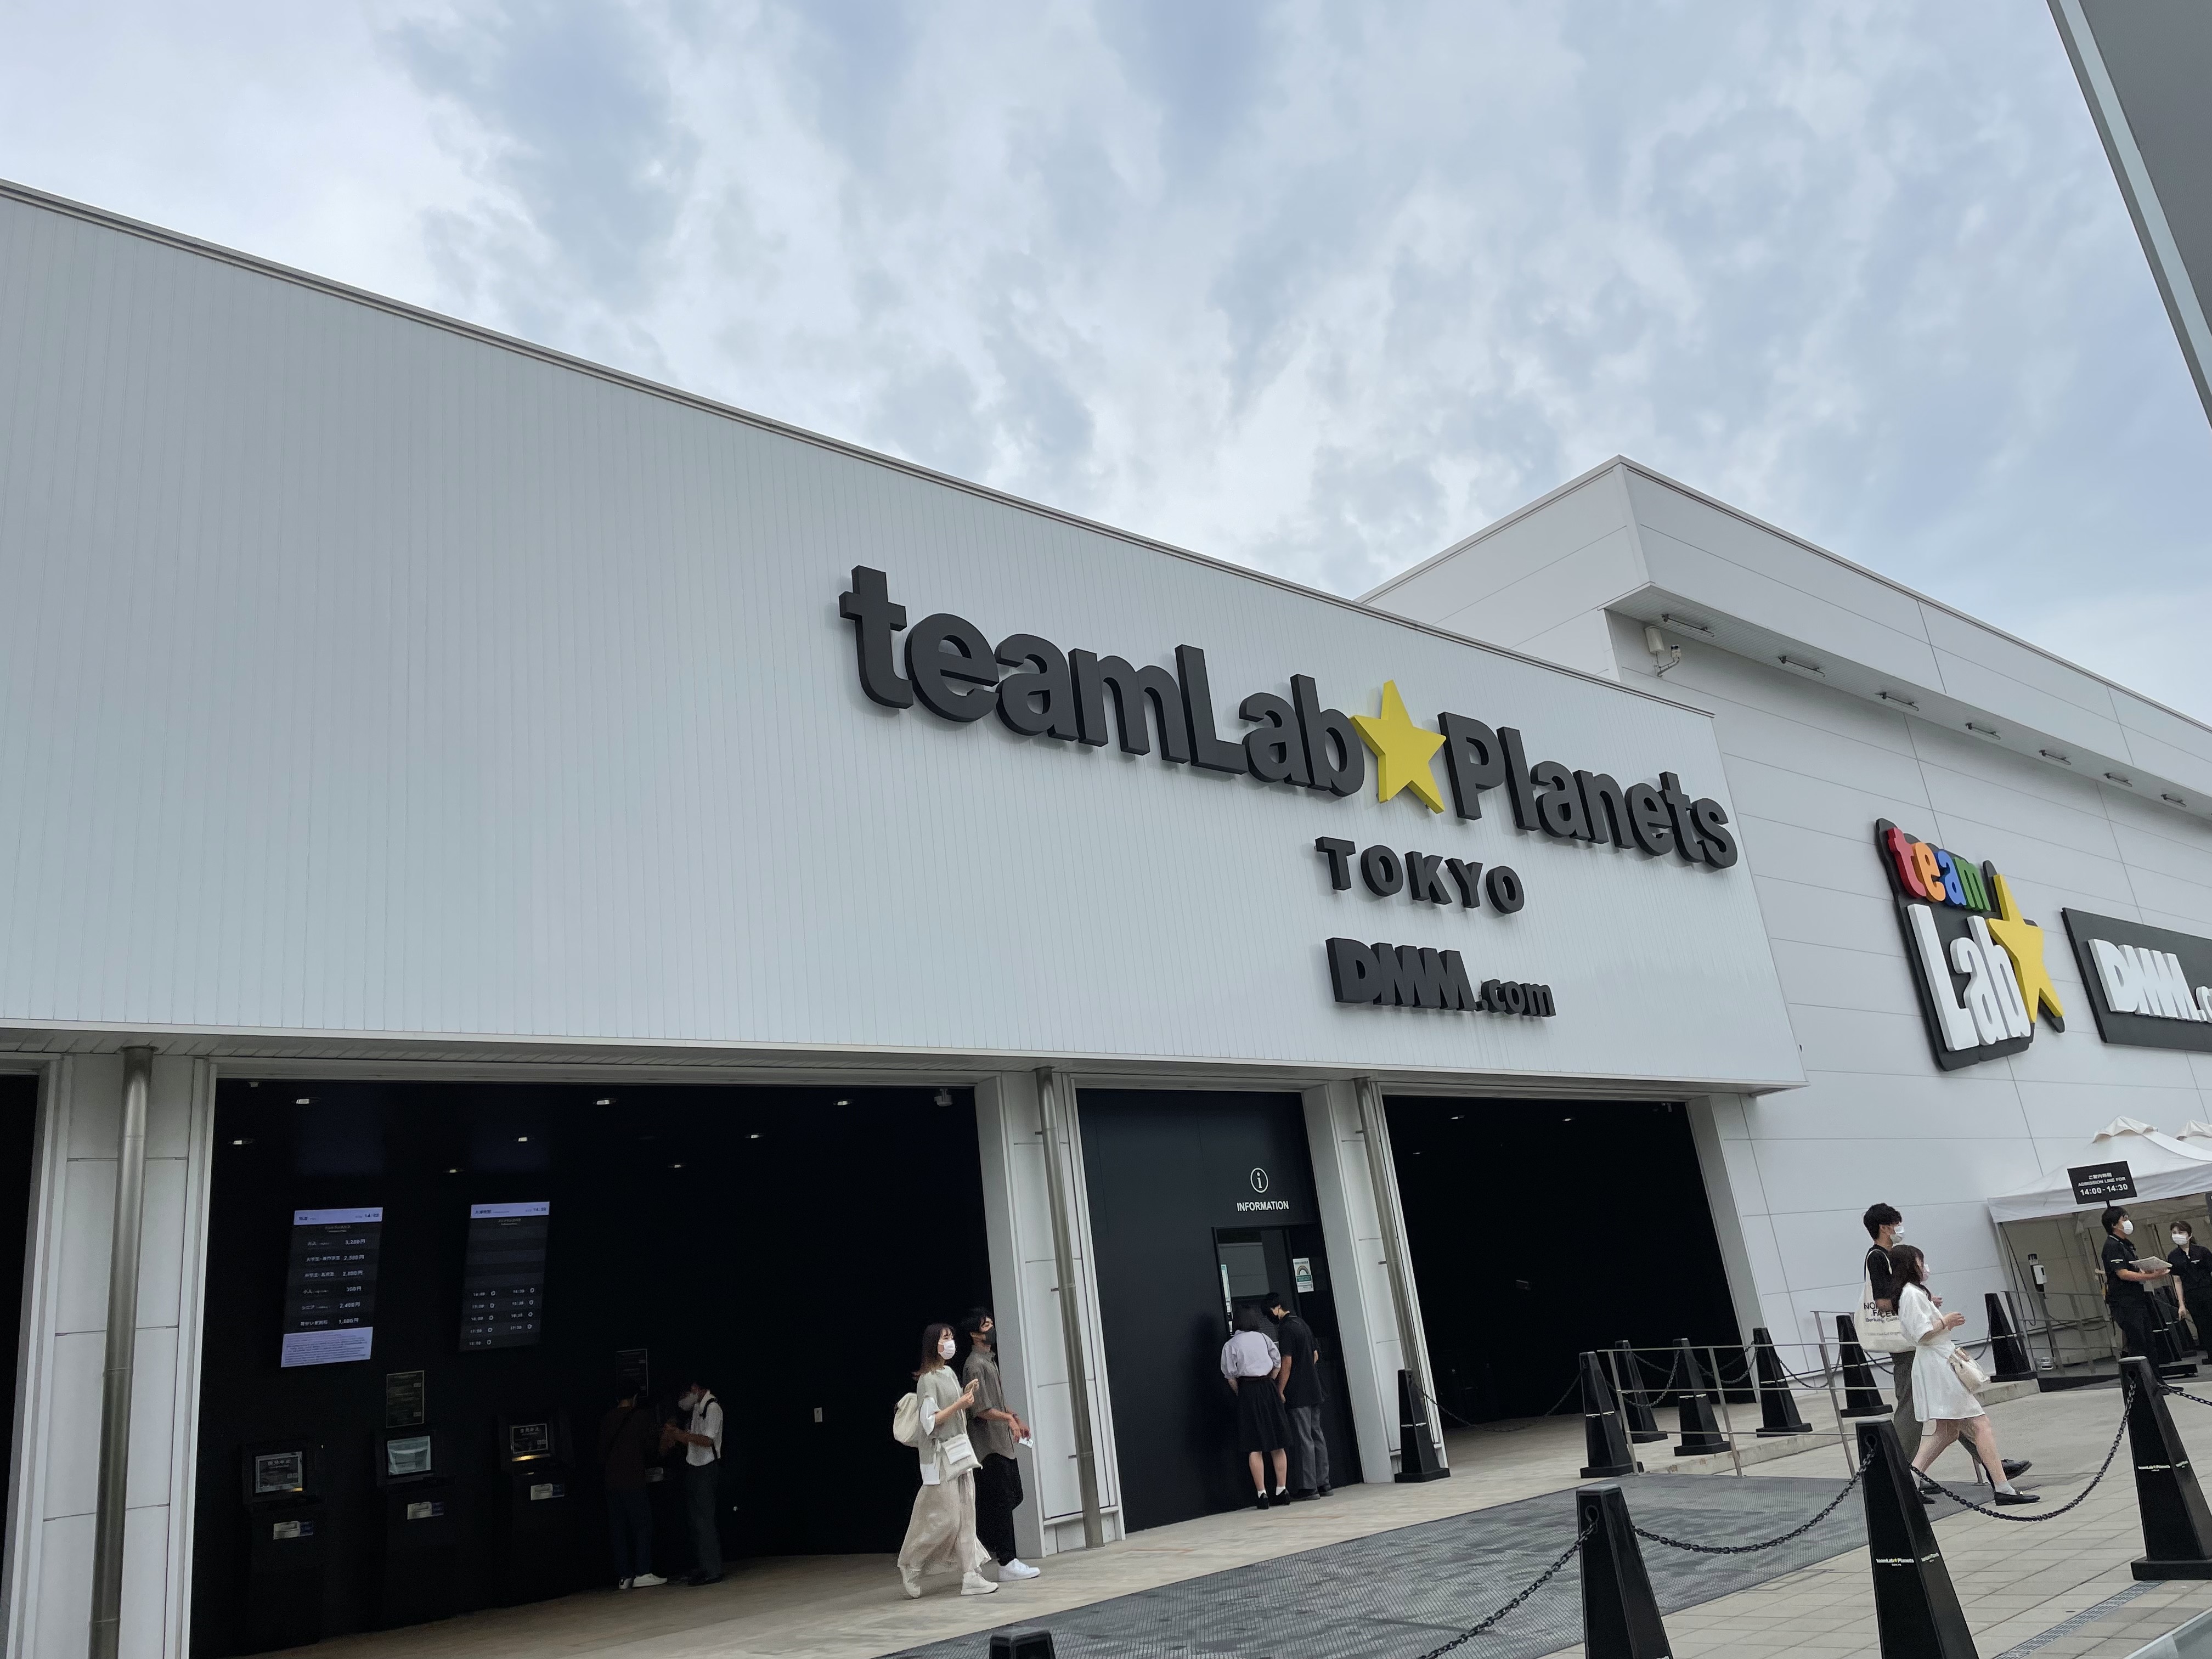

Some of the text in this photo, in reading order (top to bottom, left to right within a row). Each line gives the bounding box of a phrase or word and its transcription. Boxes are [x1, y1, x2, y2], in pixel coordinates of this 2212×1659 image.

[839, 565, 1737, 868] teamLab Planets
[1315, 837, 1524, 913] TOKYO
[1888, 827, 1991, 911] team
[1325, 937, 1556, 1017] DMM.com
[1908, 904, 2031, 1052] Lab
[1237, 1201, 1289, 1211] INFORMATION
